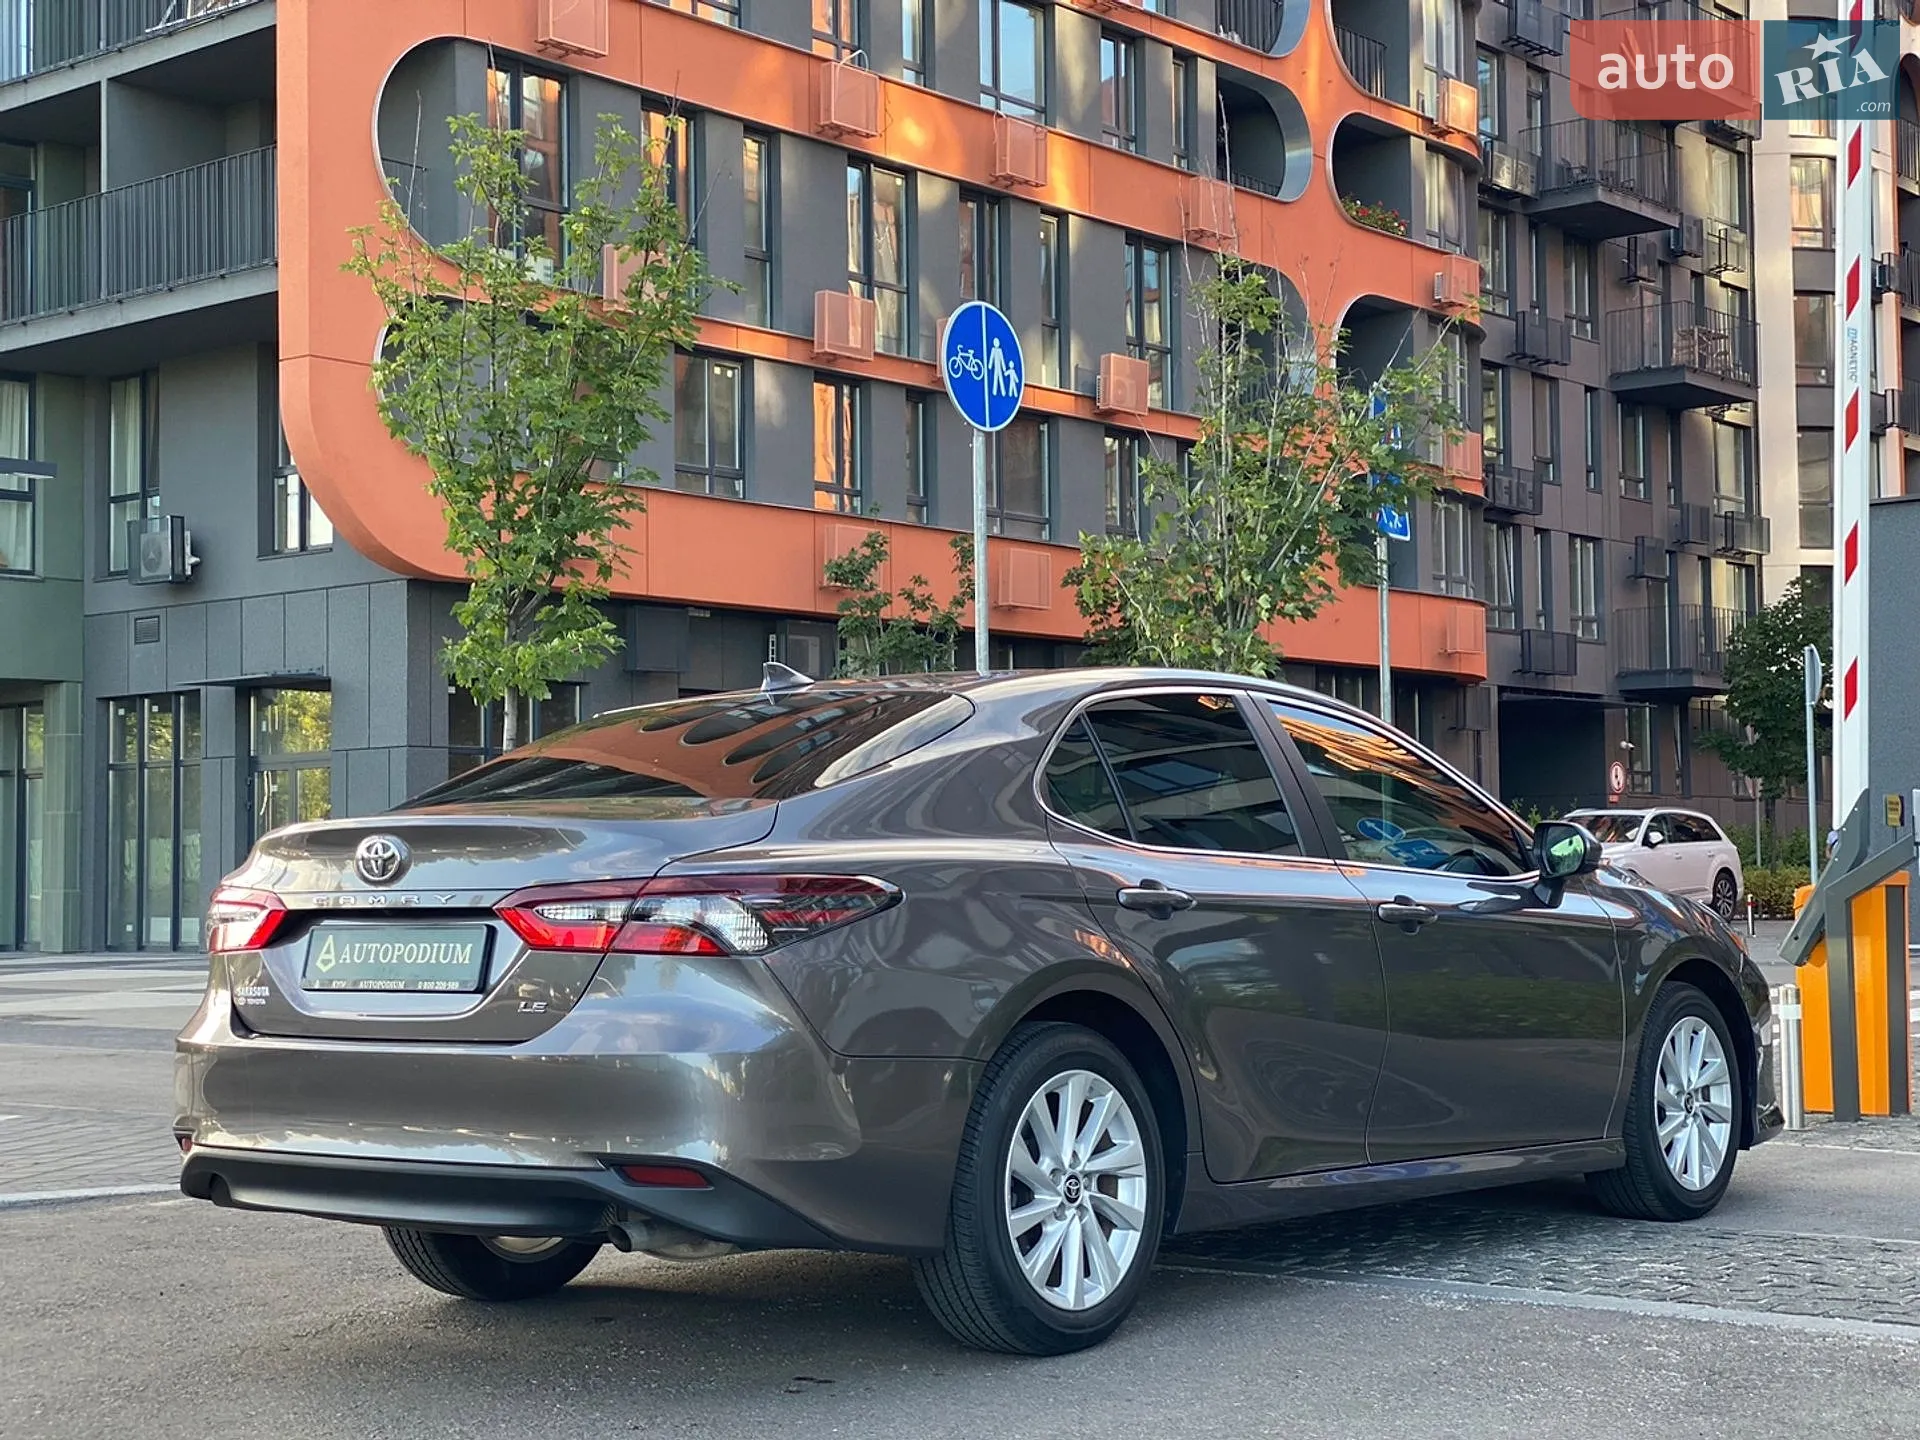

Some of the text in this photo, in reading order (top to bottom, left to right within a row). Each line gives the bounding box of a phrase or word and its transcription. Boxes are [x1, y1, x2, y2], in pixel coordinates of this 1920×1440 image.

[312, 893, 457, 906] CAMRY
[339, 942, 473, 965] AUTOPODIUM
[359, 979, 406, 990] AUTOPODIUM
[517, 1001, 548, 1013] LE
